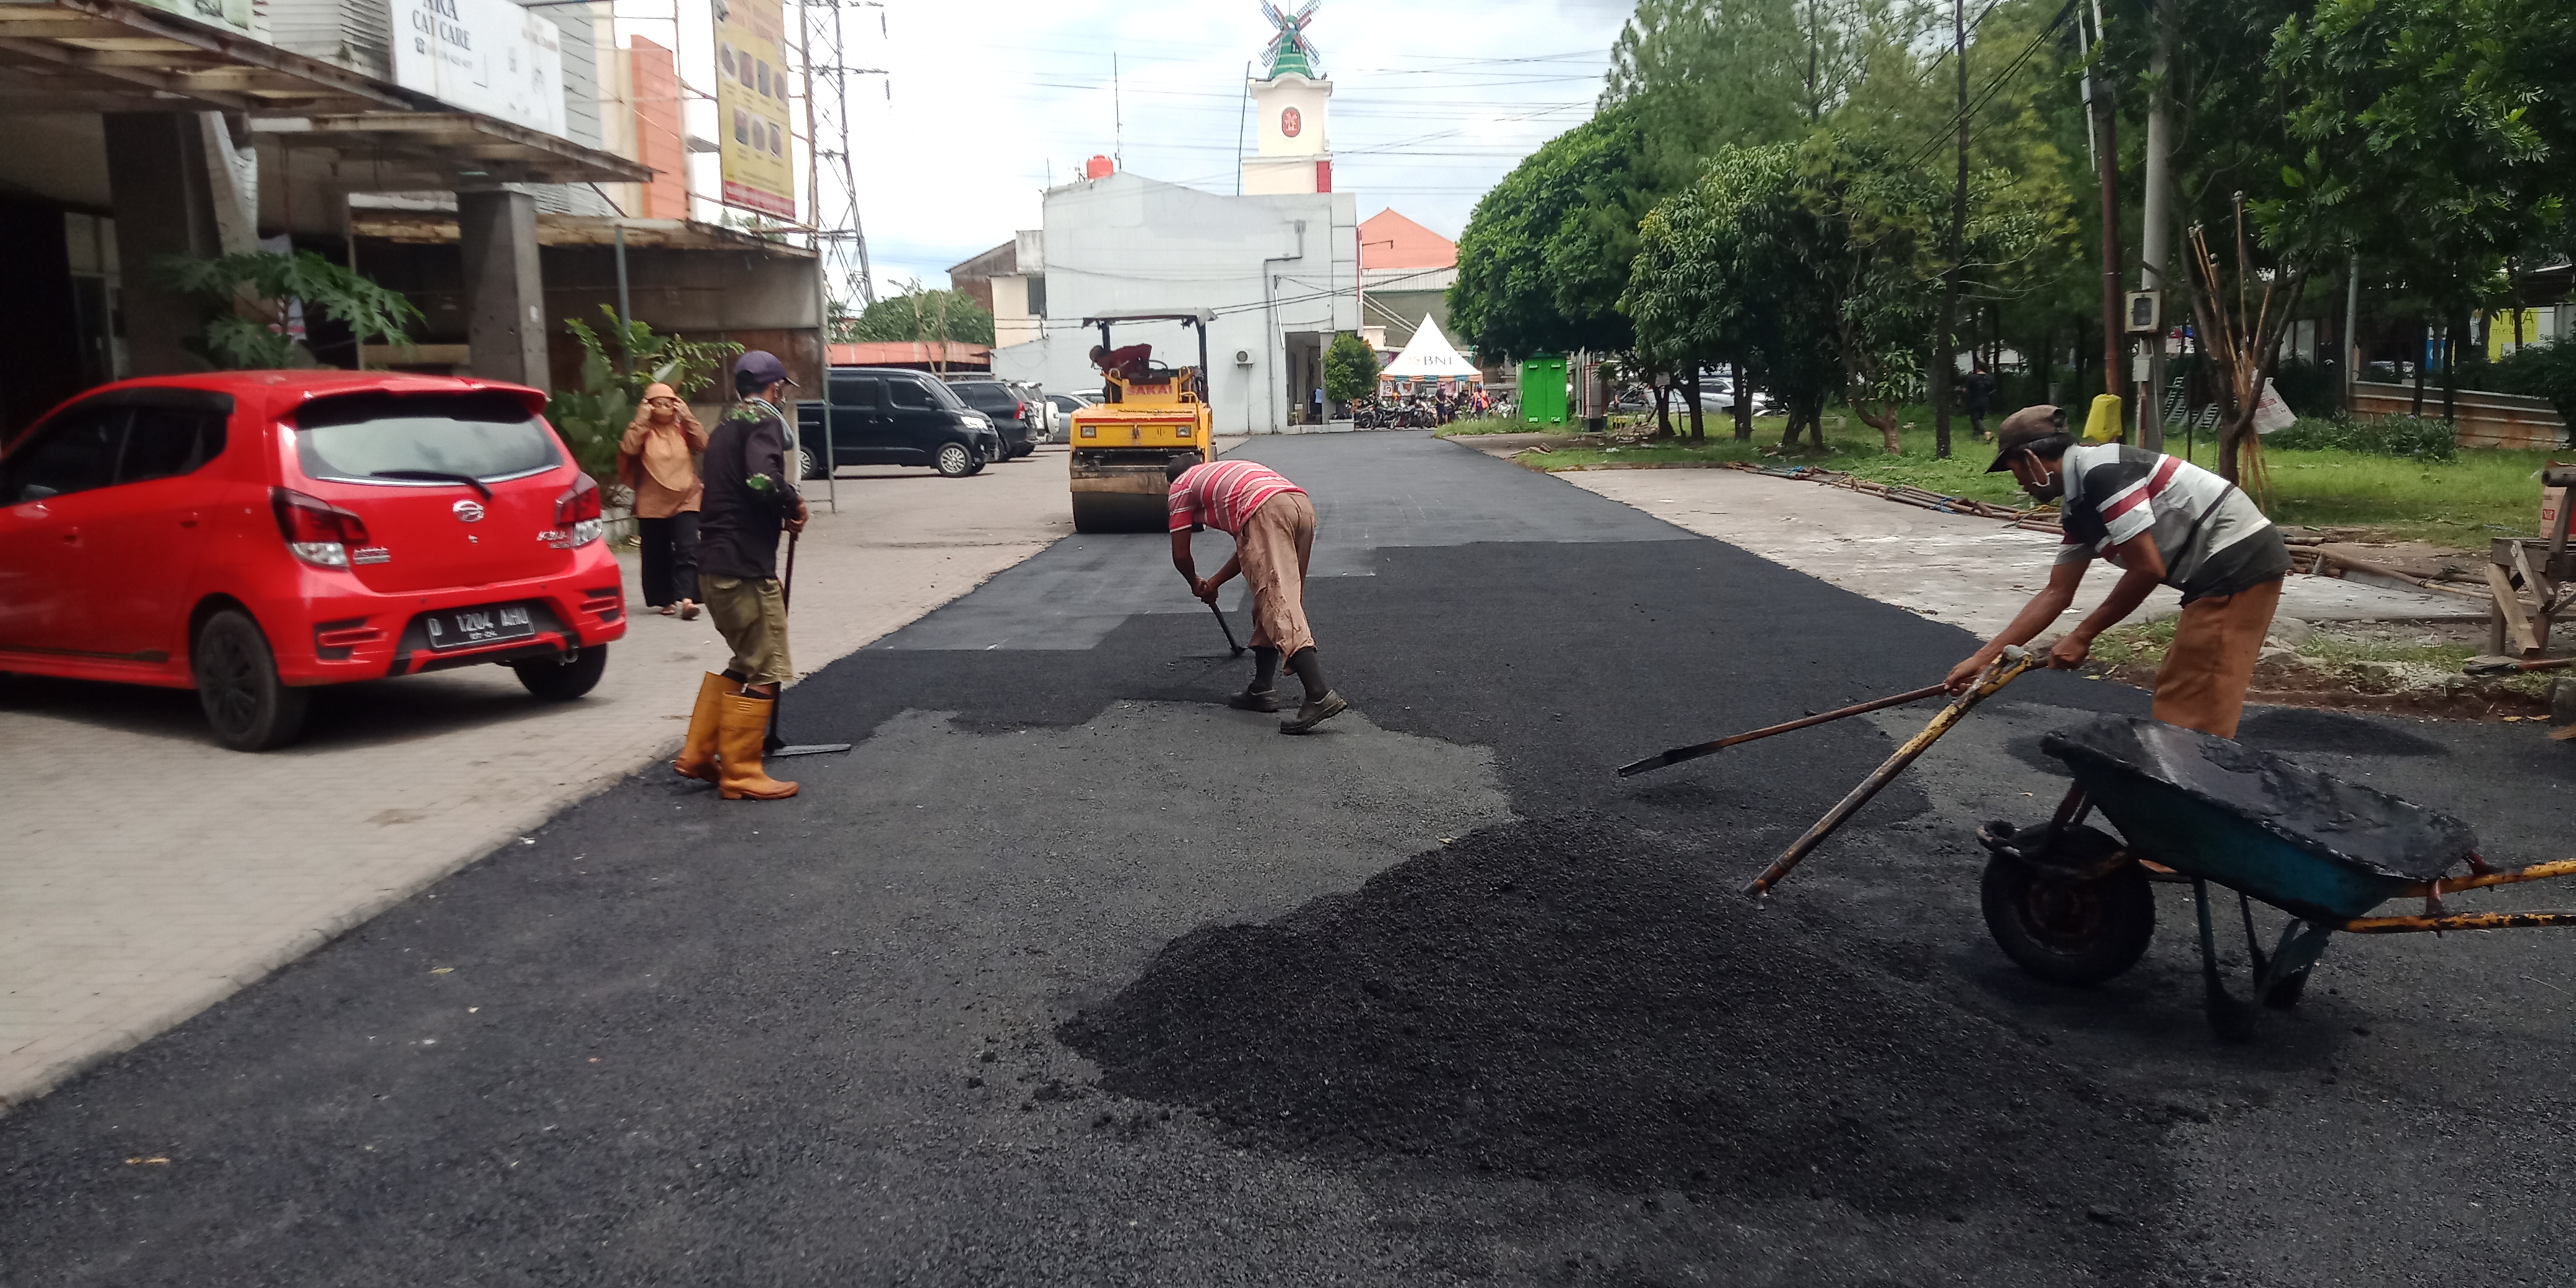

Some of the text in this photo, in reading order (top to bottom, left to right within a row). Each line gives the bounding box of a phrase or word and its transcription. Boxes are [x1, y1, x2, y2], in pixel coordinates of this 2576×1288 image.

[440, 21, 471, 51] CARE
[1424, 355, 1451, 365] BNI
[1127, 385, 1173, 395] SAKAI
[428, 618, 442, 636] D
[456, 612, 494, 632] 1204
